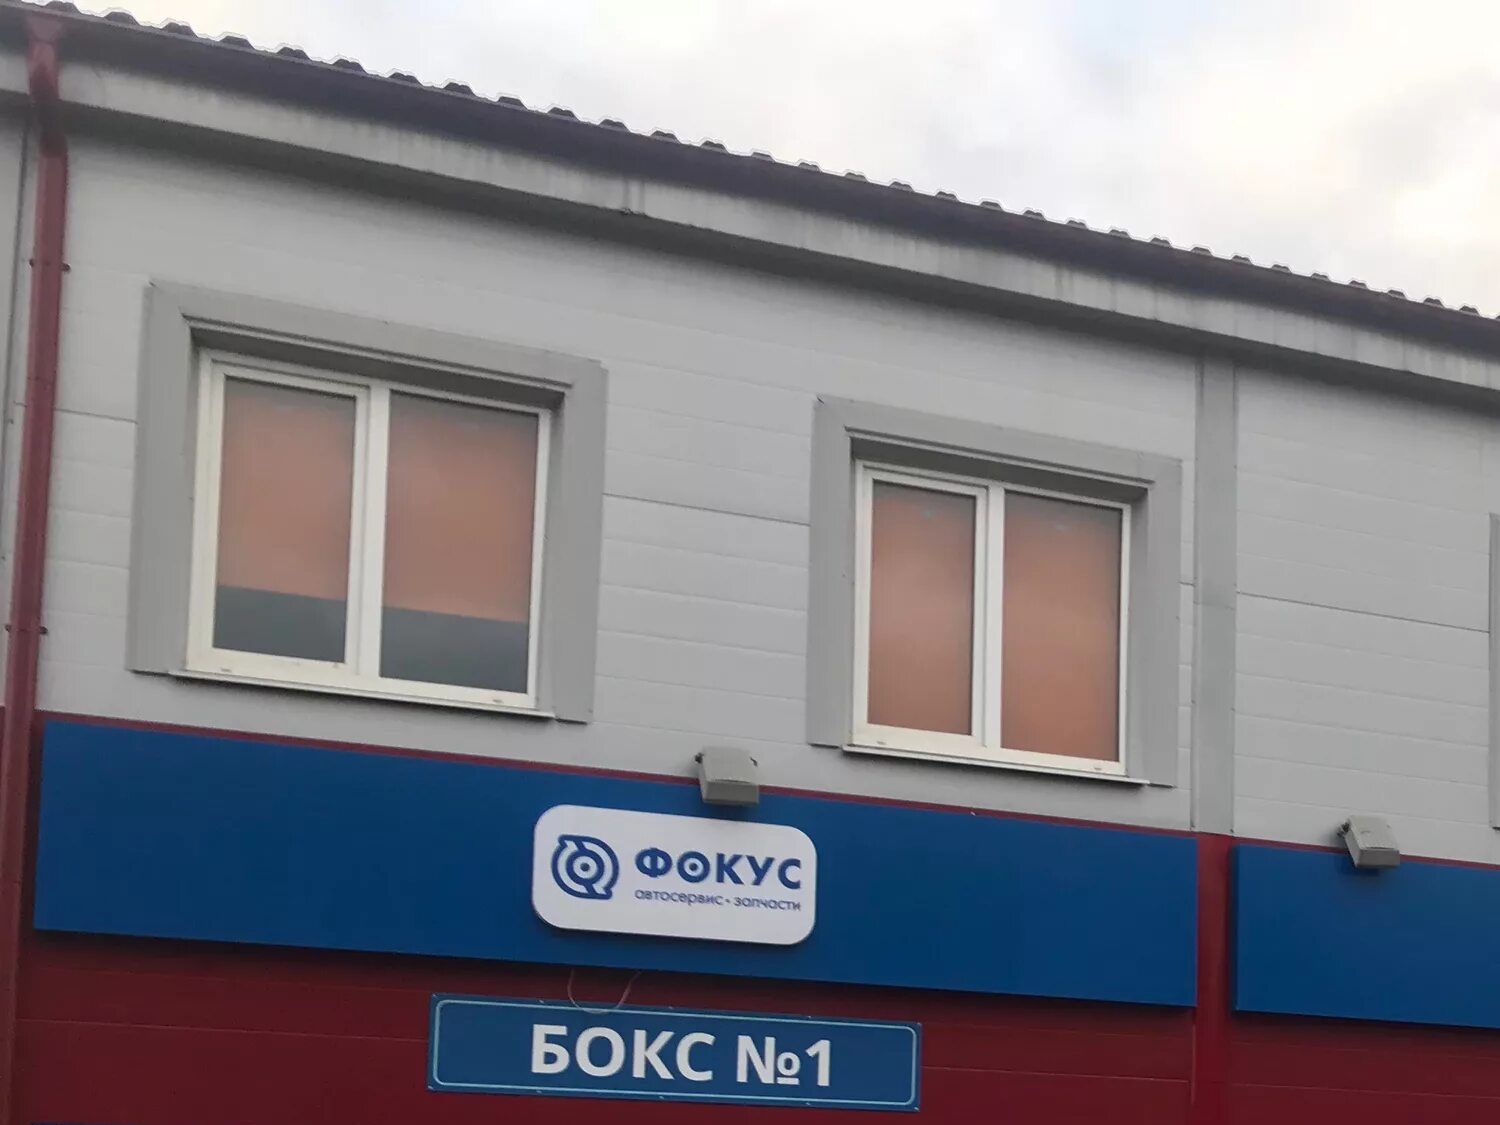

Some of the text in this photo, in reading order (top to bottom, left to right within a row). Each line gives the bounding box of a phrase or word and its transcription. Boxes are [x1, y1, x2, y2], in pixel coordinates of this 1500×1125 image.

[634, 847, 802, 890] ФОКУС
[634, 888, 802, 912] автосервис запчасти
[530, 1023, 832, 1087] БОКС №1
